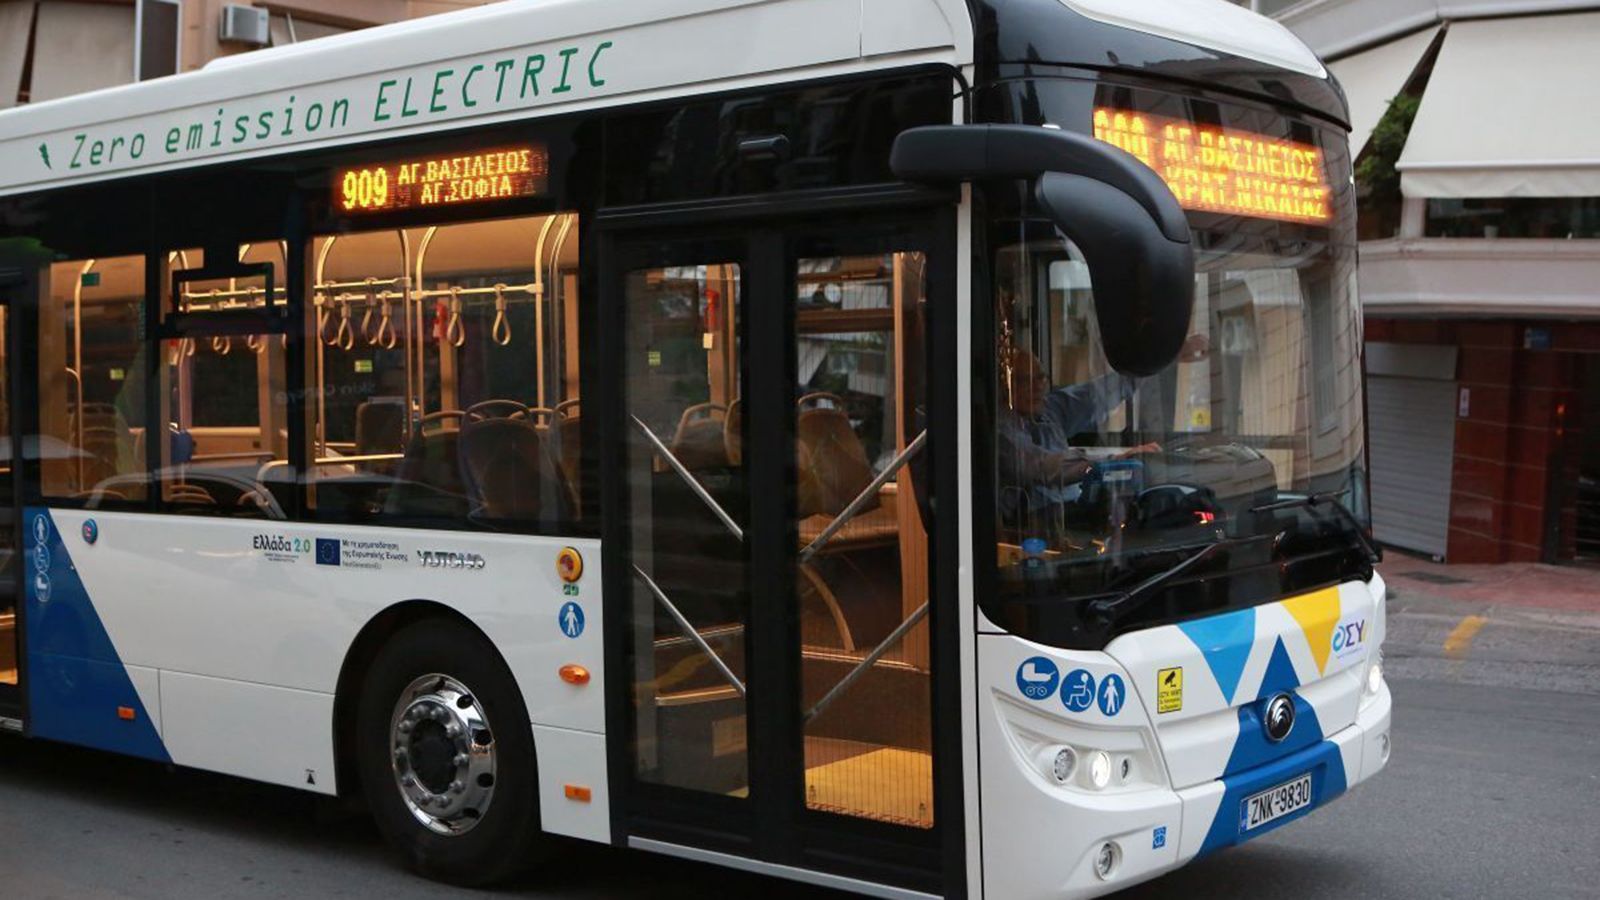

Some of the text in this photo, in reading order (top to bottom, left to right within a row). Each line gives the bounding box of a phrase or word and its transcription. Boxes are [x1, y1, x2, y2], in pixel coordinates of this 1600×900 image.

[68, 41, 613, 170] Zero emission ELECTRIC
[398, 150, 530, 185] ΑΓ.ΒΑΣΙΛΕΙΟΣ
[342, 167, 388, 209] 909
[421, 175, 512, 204] ΑΓ.ΣΟΦΙΑ
[253, 533, 311, 553] Ελλάδα 2.0
